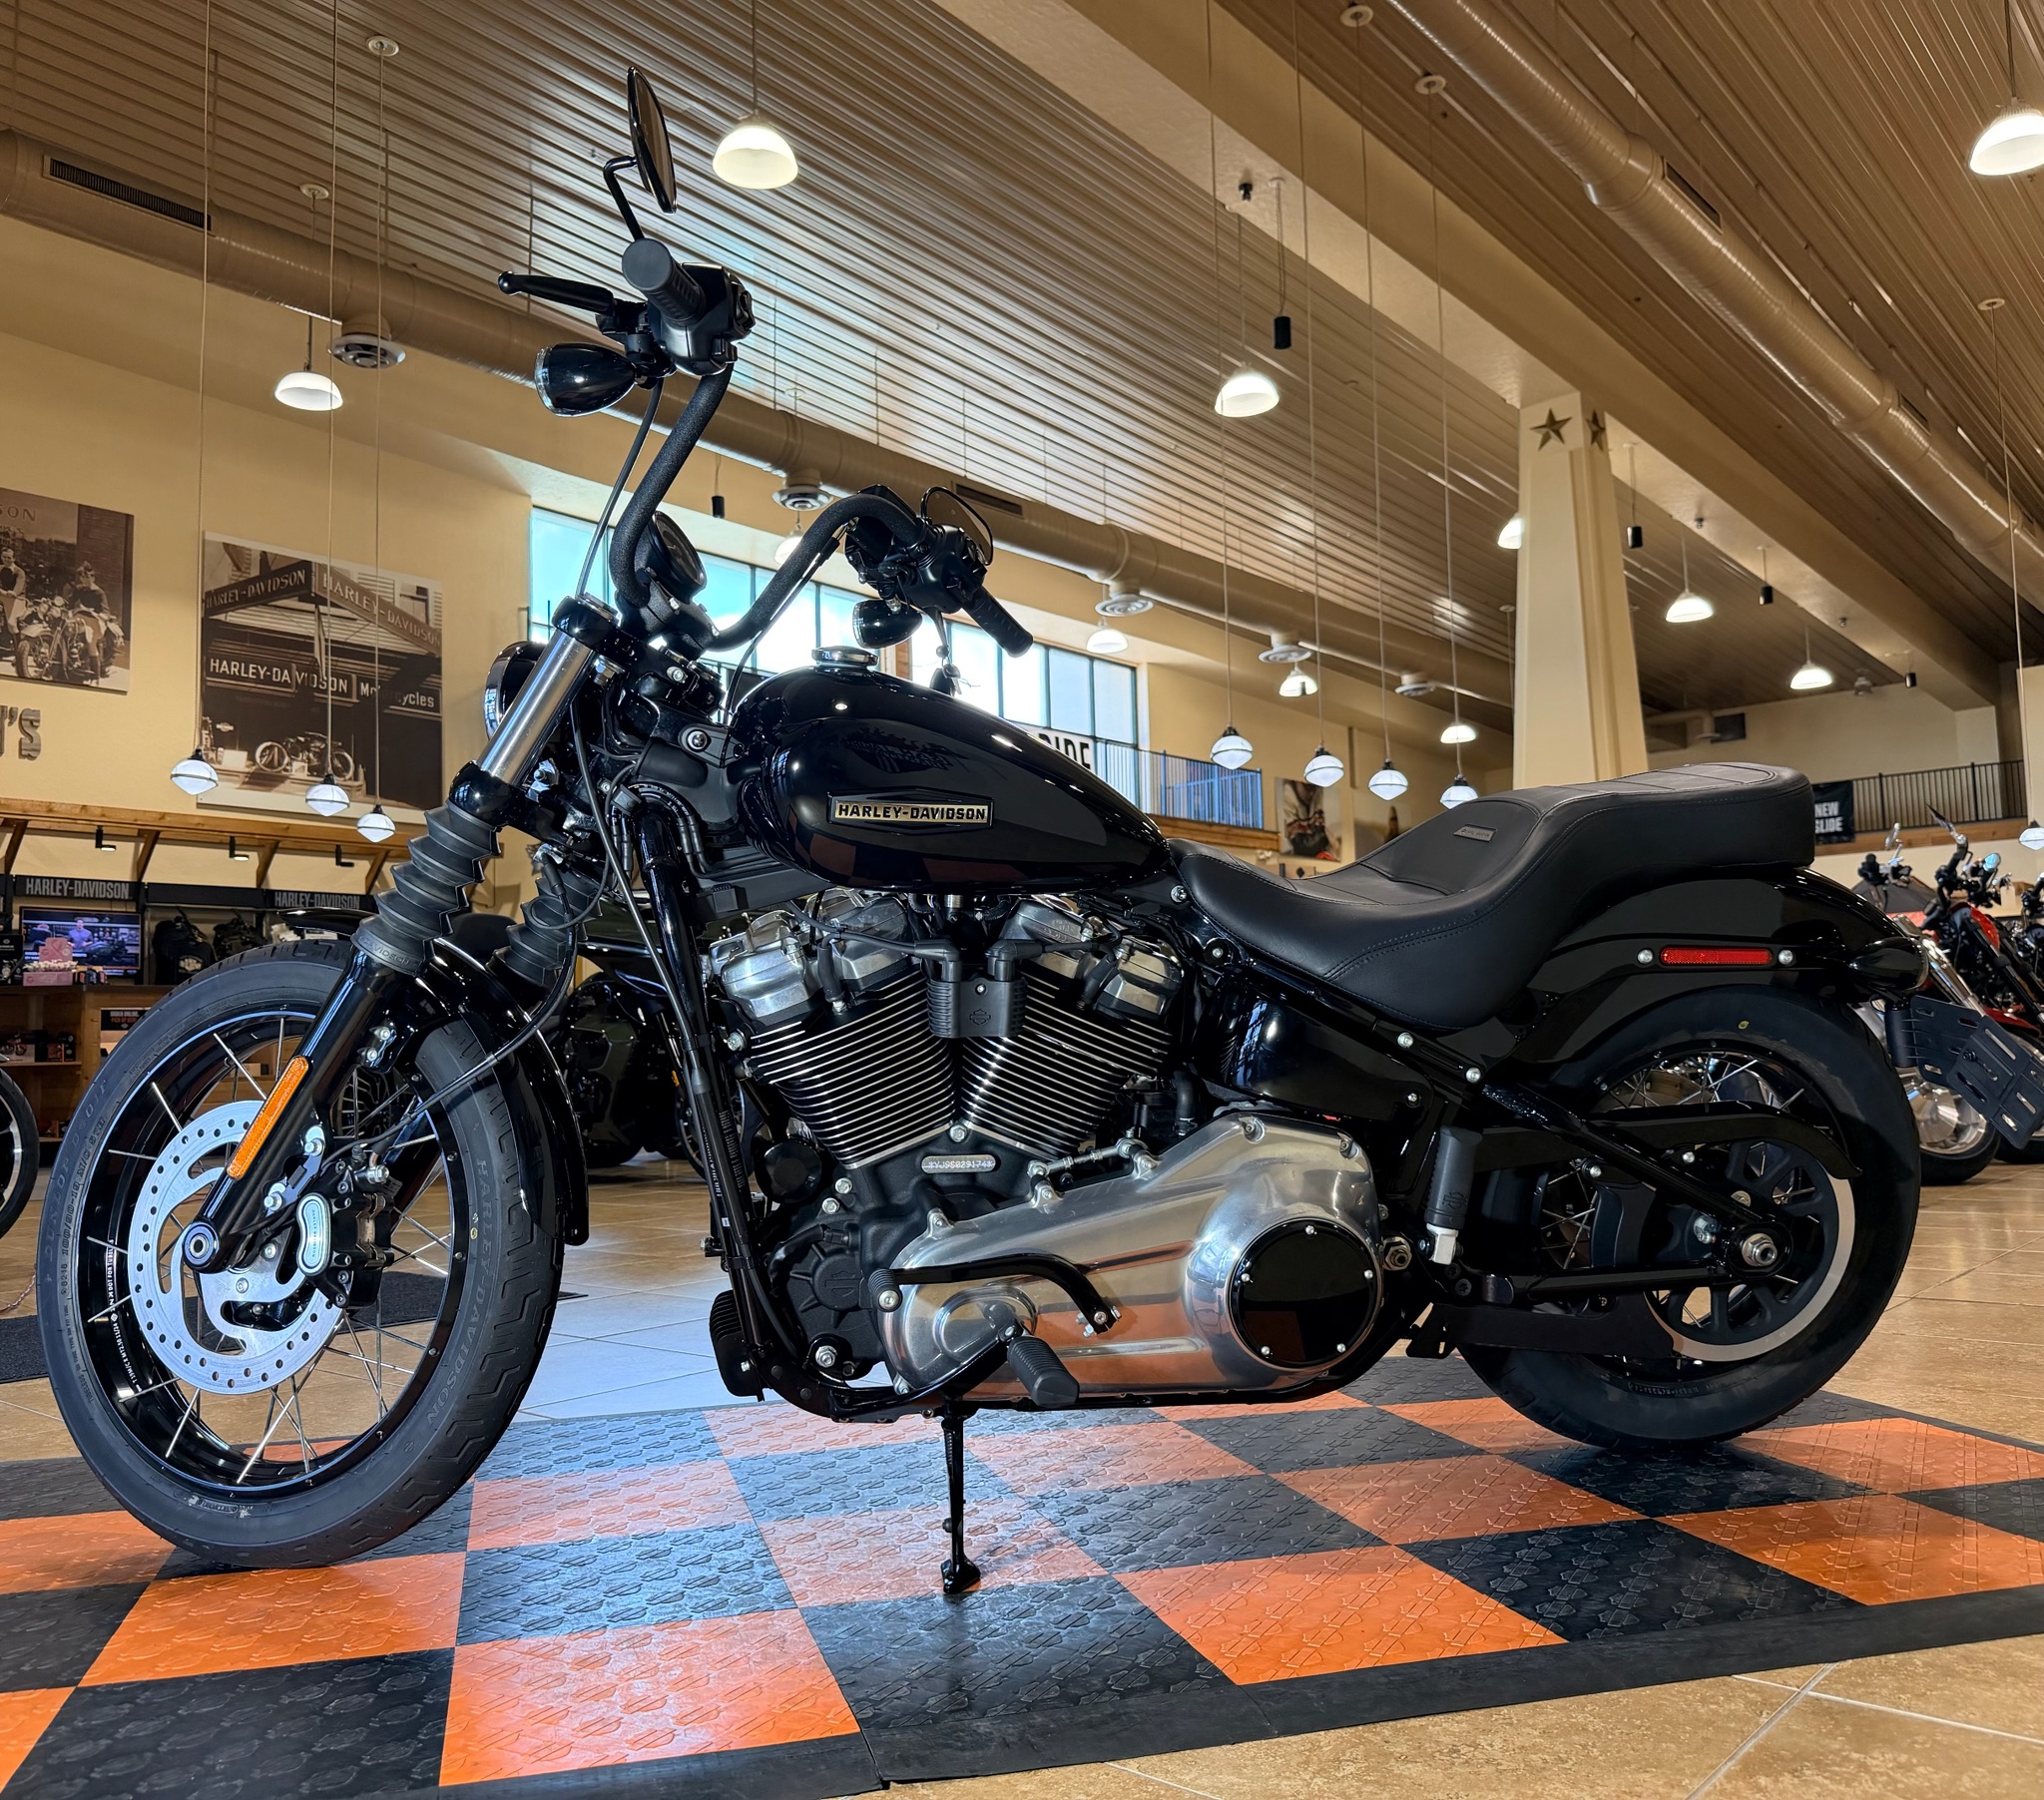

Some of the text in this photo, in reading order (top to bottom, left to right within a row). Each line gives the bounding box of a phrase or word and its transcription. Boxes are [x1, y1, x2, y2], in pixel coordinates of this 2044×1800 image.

[206, 569, 306, 610] HARLEY-DAVIDSON
[323, 573, 441, 648] HARLEY-DAVIDSON
[838, 804, 986, 821] HARLEY-DAVIDSON
[26, 878, 130, 899] HARLEY-DAVIDSON
[274, 891, 360, 911] HARLEY-DAVIDSON
[426, 1158, 490, 1427] HARLEY-DAVIDSON
